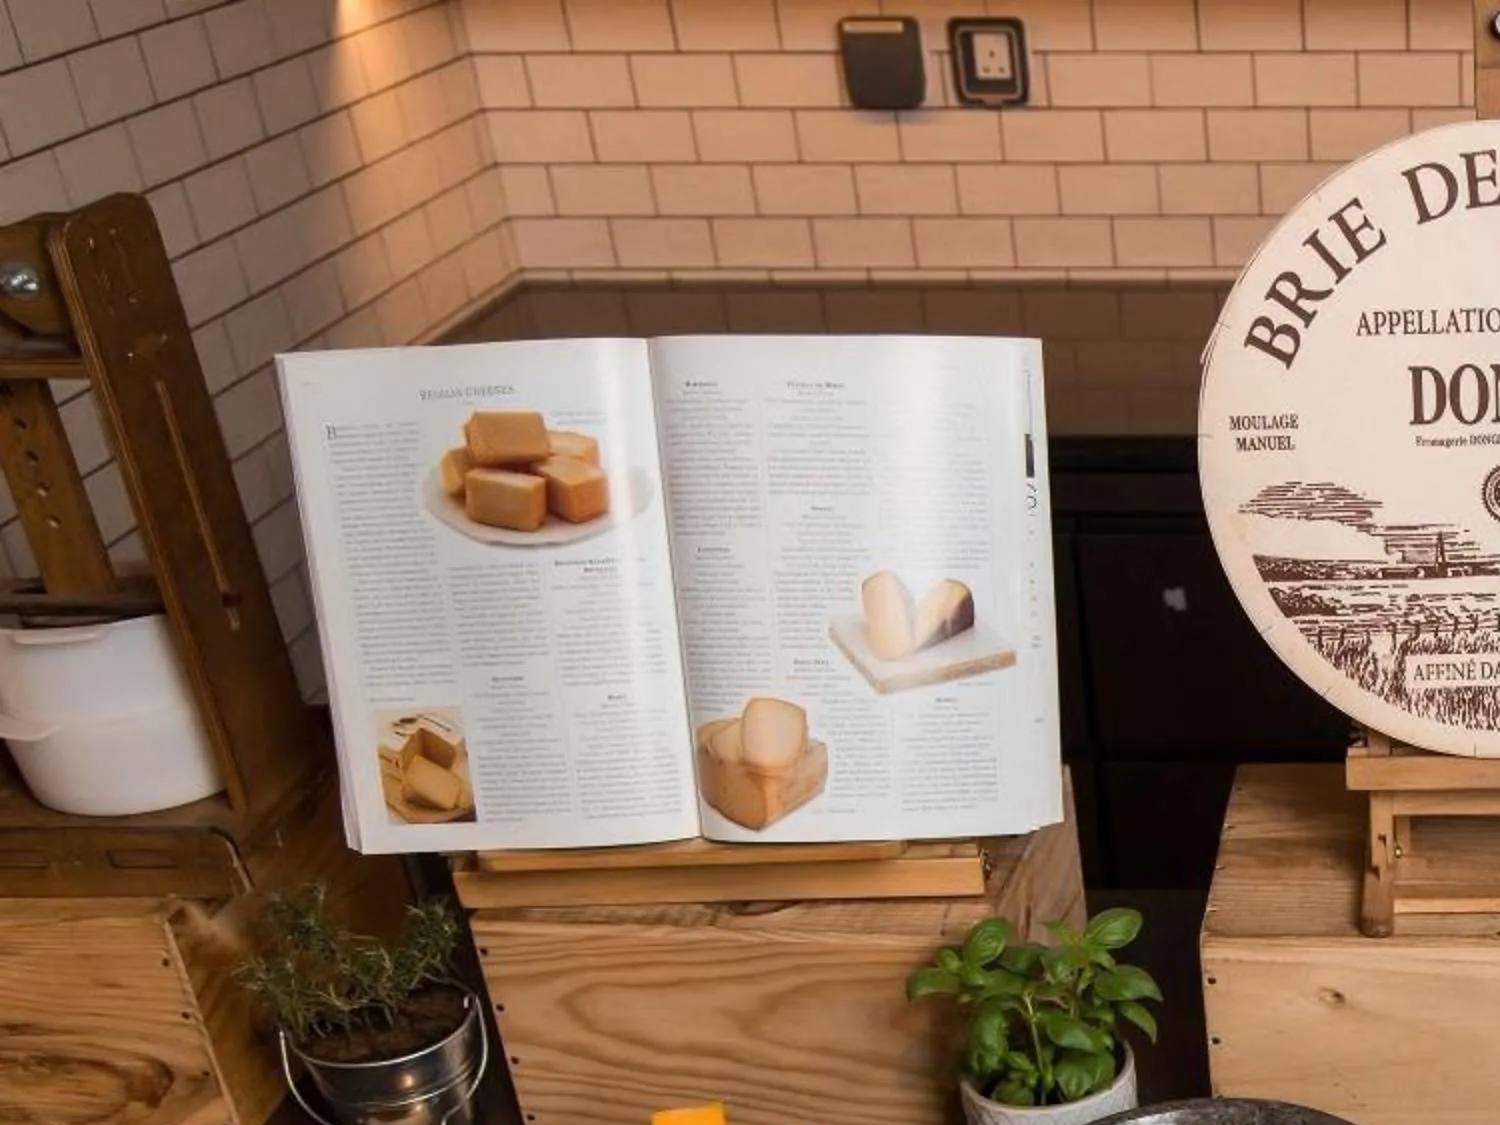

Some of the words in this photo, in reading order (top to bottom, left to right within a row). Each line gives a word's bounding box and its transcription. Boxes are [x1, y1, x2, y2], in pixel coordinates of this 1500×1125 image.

[1244, 197, 1387, 369] BRIE
[1229, 413, 1299, 431] MOULAGE
[1235, 435, 1296, 452] MANUEL
[1413, 659, 1477, 682] AFFINÉ
